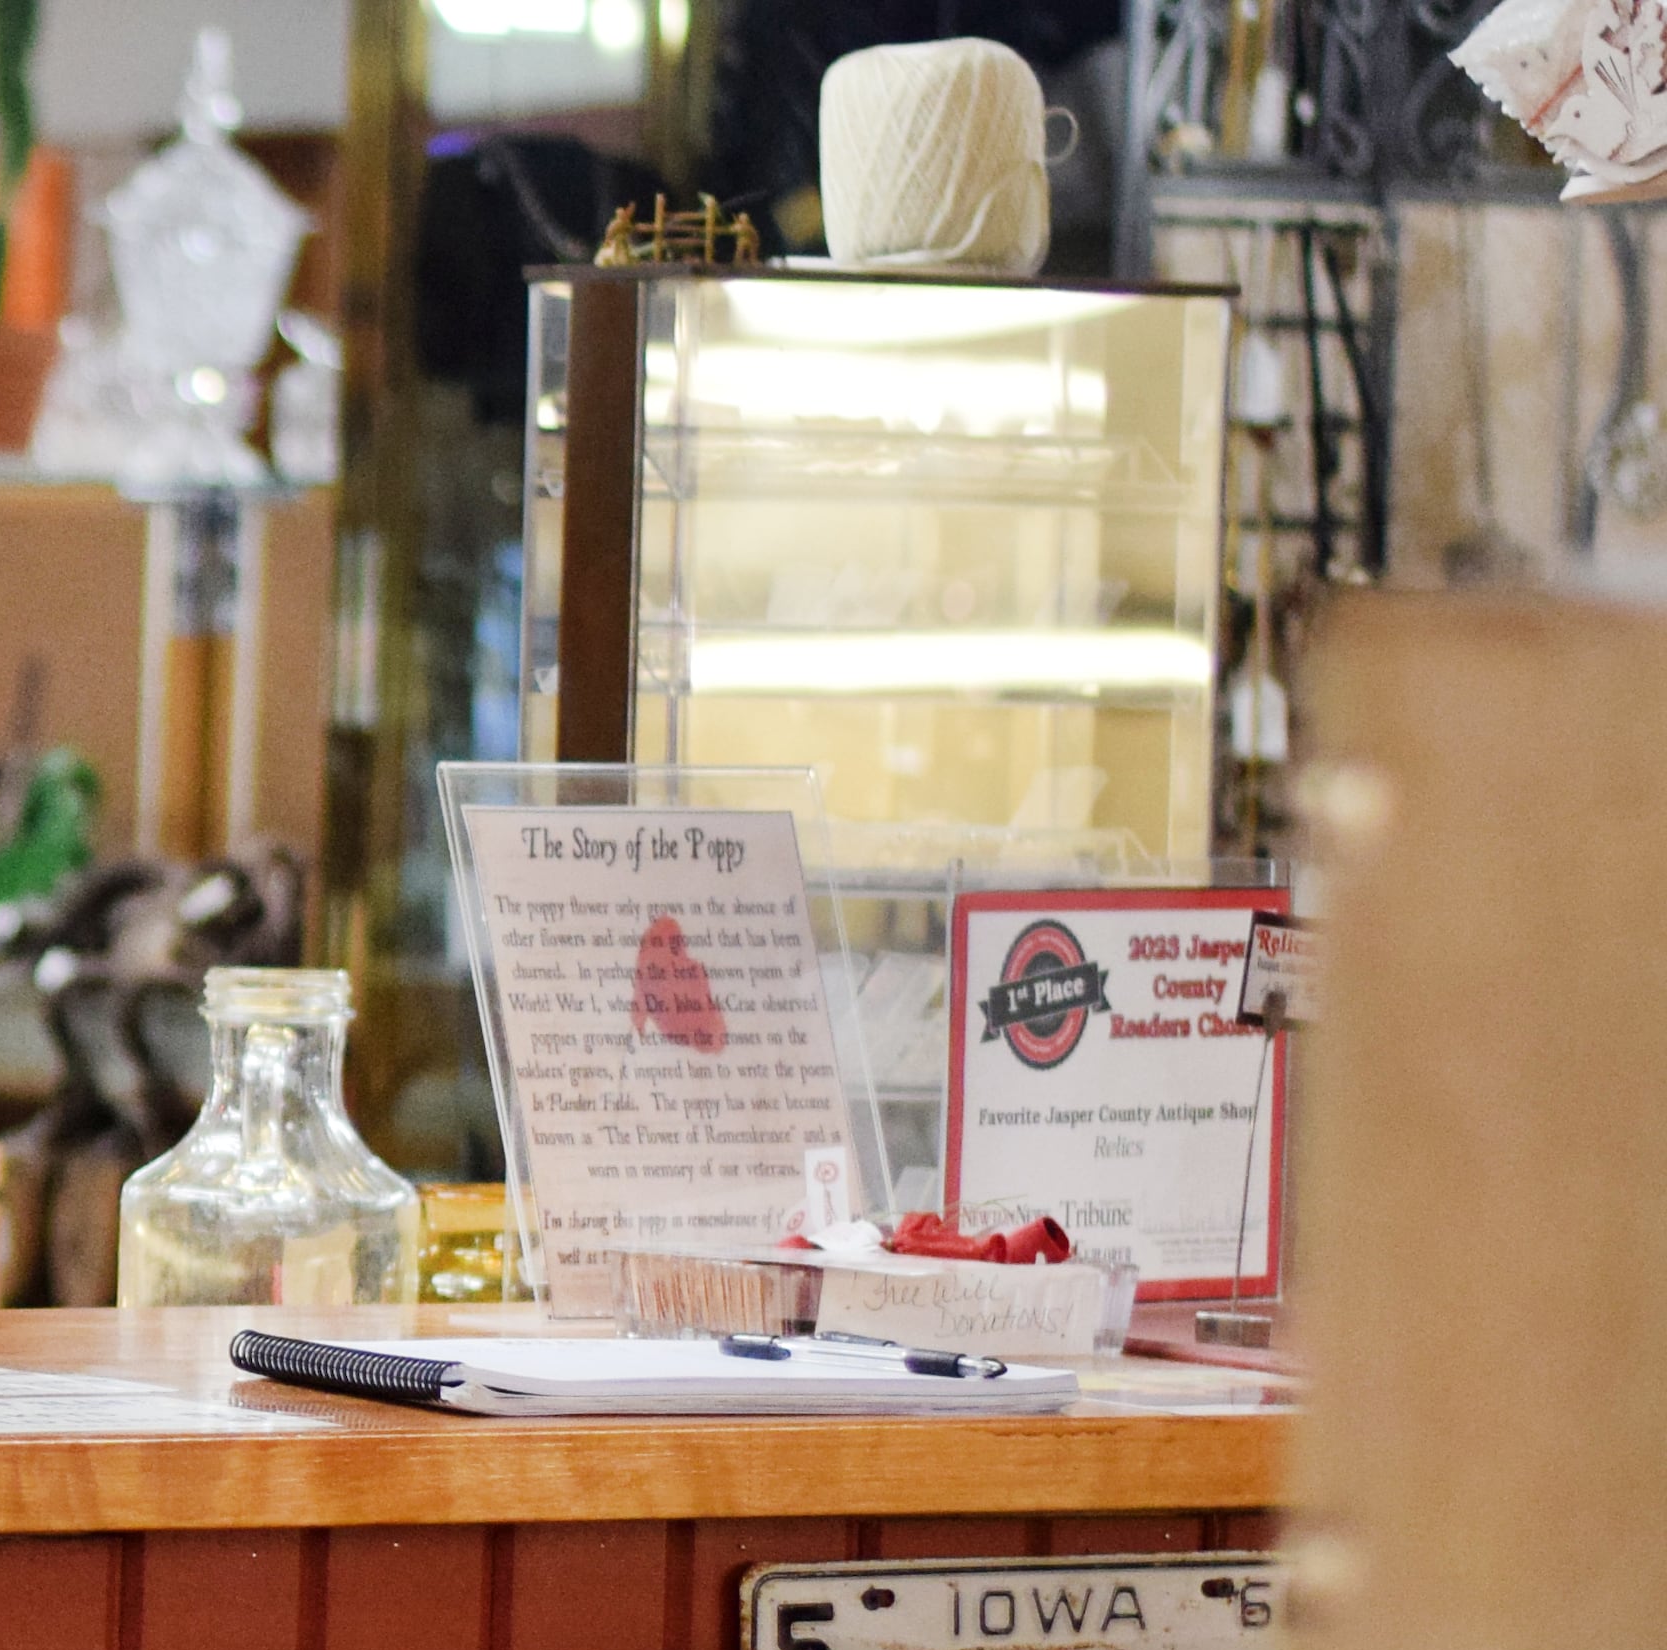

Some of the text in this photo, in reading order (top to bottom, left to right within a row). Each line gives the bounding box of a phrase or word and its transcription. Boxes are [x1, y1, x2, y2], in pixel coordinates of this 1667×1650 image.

[522, 826, 746, 872] The Story of the Poppy
[495, 895, 522, 915] The
[527, 897, 565, 923] poppy
[1129, 934, 1245, 967] 2023 Jaspe
[1034, 976, 1086, 1005] Place
[1153, 974, 1228, 1004] County
[1110, 1014, 1192, 1039] Readers
[978, 1107, 1042, 1127] Favorite
[1045, 1106, 1094, 1129] Jasper
[1099, 1105, 1152, 1127] County
[1156, 1103, 1215, 1126] Antique
[636, 1125, 680, 1145] Flower
[1094, 1136, 1145, 1160] Relics
[642, 1165, 694, 1183] memory
[1060, 1202, 1133, 1229] Tribune
[953, 1584, 1147, 1637] IOWA
